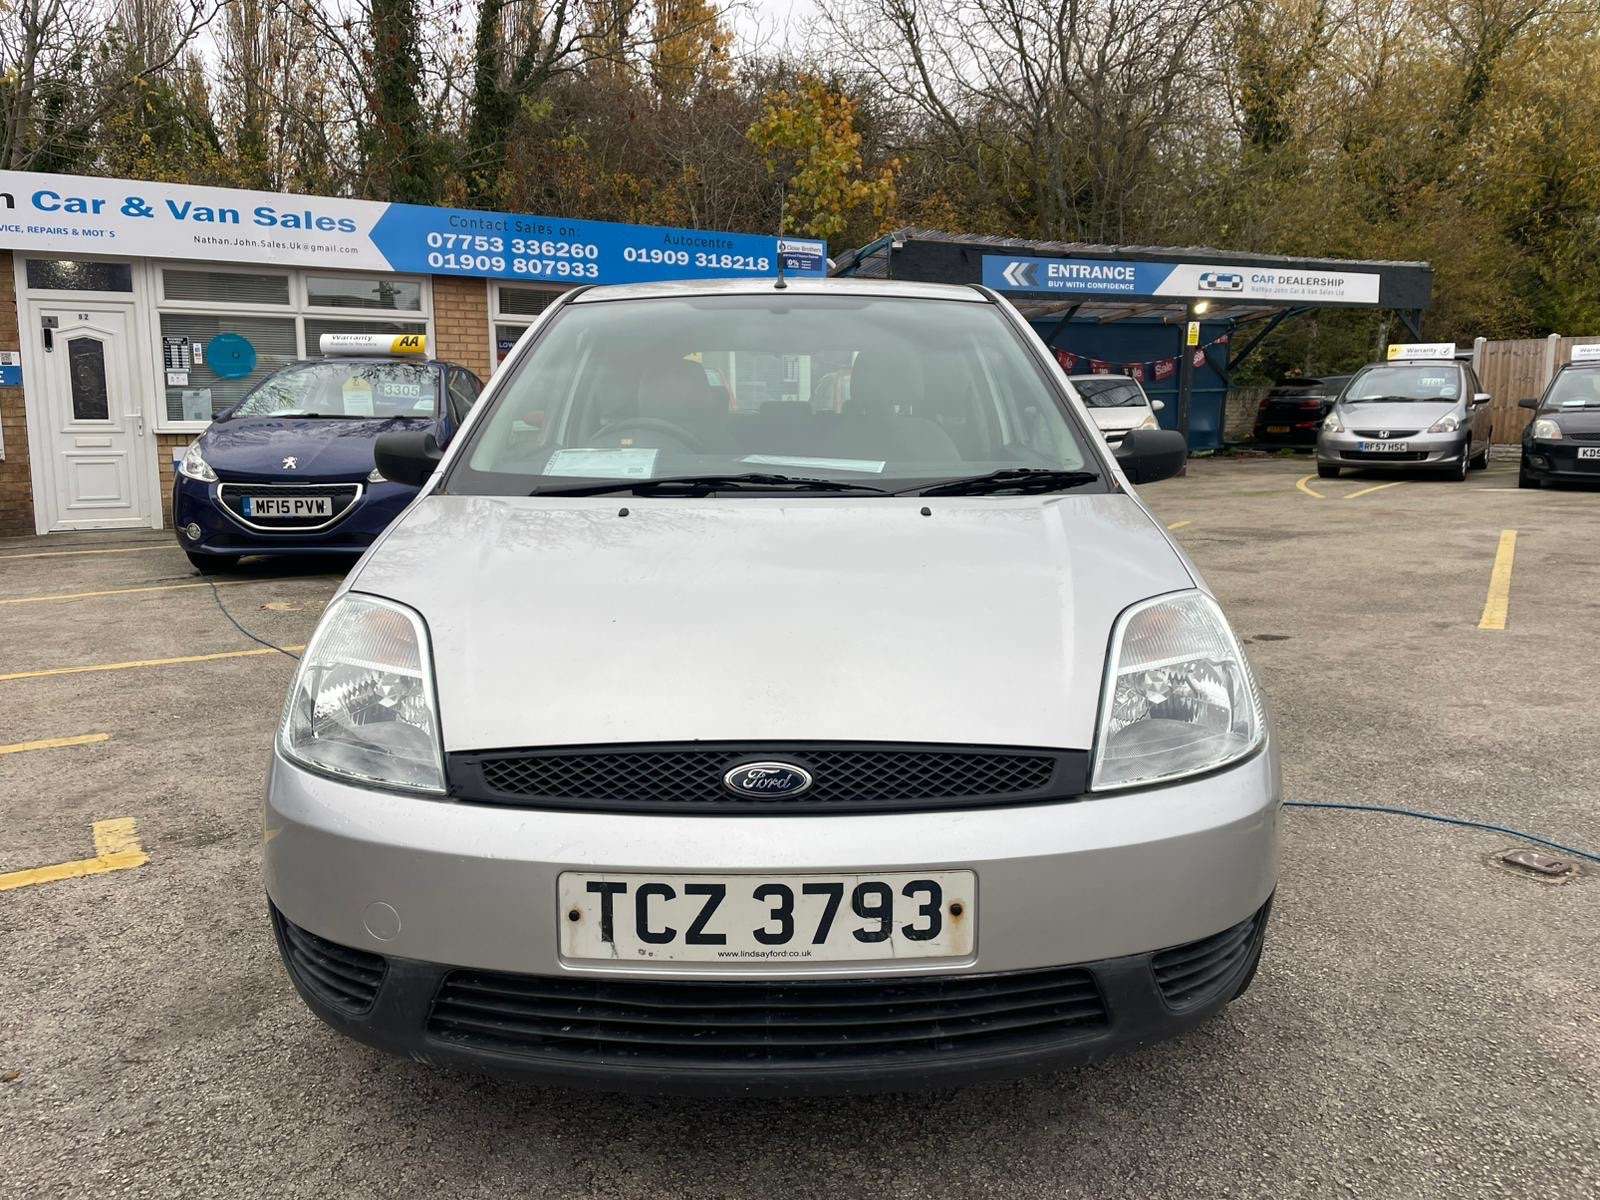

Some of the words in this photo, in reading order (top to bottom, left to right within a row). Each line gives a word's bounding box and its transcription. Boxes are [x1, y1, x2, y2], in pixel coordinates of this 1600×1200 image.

[32, 190, 106, 214] Car
[120, 196, 154, 217] &
[166, 200, 240, 224] Van
[253, 206, 357, 233] Sales
[27, 225, 69, 236] REPAIRS
[72, 228, 79, 236] &
[449, 215, 509, 232] Contact
[515, 221, 553, 236] Sales
[426, 232, 504, 252] 07753
[511, 239, 599, 259] 336260
[664, 234, 735, 249] Autocentre
[428, 252, 506, 272] 01909
[513, 258, 599, 278] 807933
[624, 247, 690, 265] 01909
[695, 252, 770, 271] 318218
[1048, 264, 1135, 280] ENTRANCE
[1087, 282, 1135, 290] CONFIDENCE
[1251, 274, 1275, 284] CAR
[1278, 277, 1345, 287] DEALERSHIP
[400, 336, 418, 346] AA
[1364, 442, 1388, 451] RF57
[256, 500, 290, 513] MF15
[295, 500, 325, 514] PVW
[743, 768, 793, 789] Ford
[586, 881, 727, 945] TCZ
[752, 880, 943, 945] 3793
[718, 950, 812, 959] www.lindsayford.co.uk
